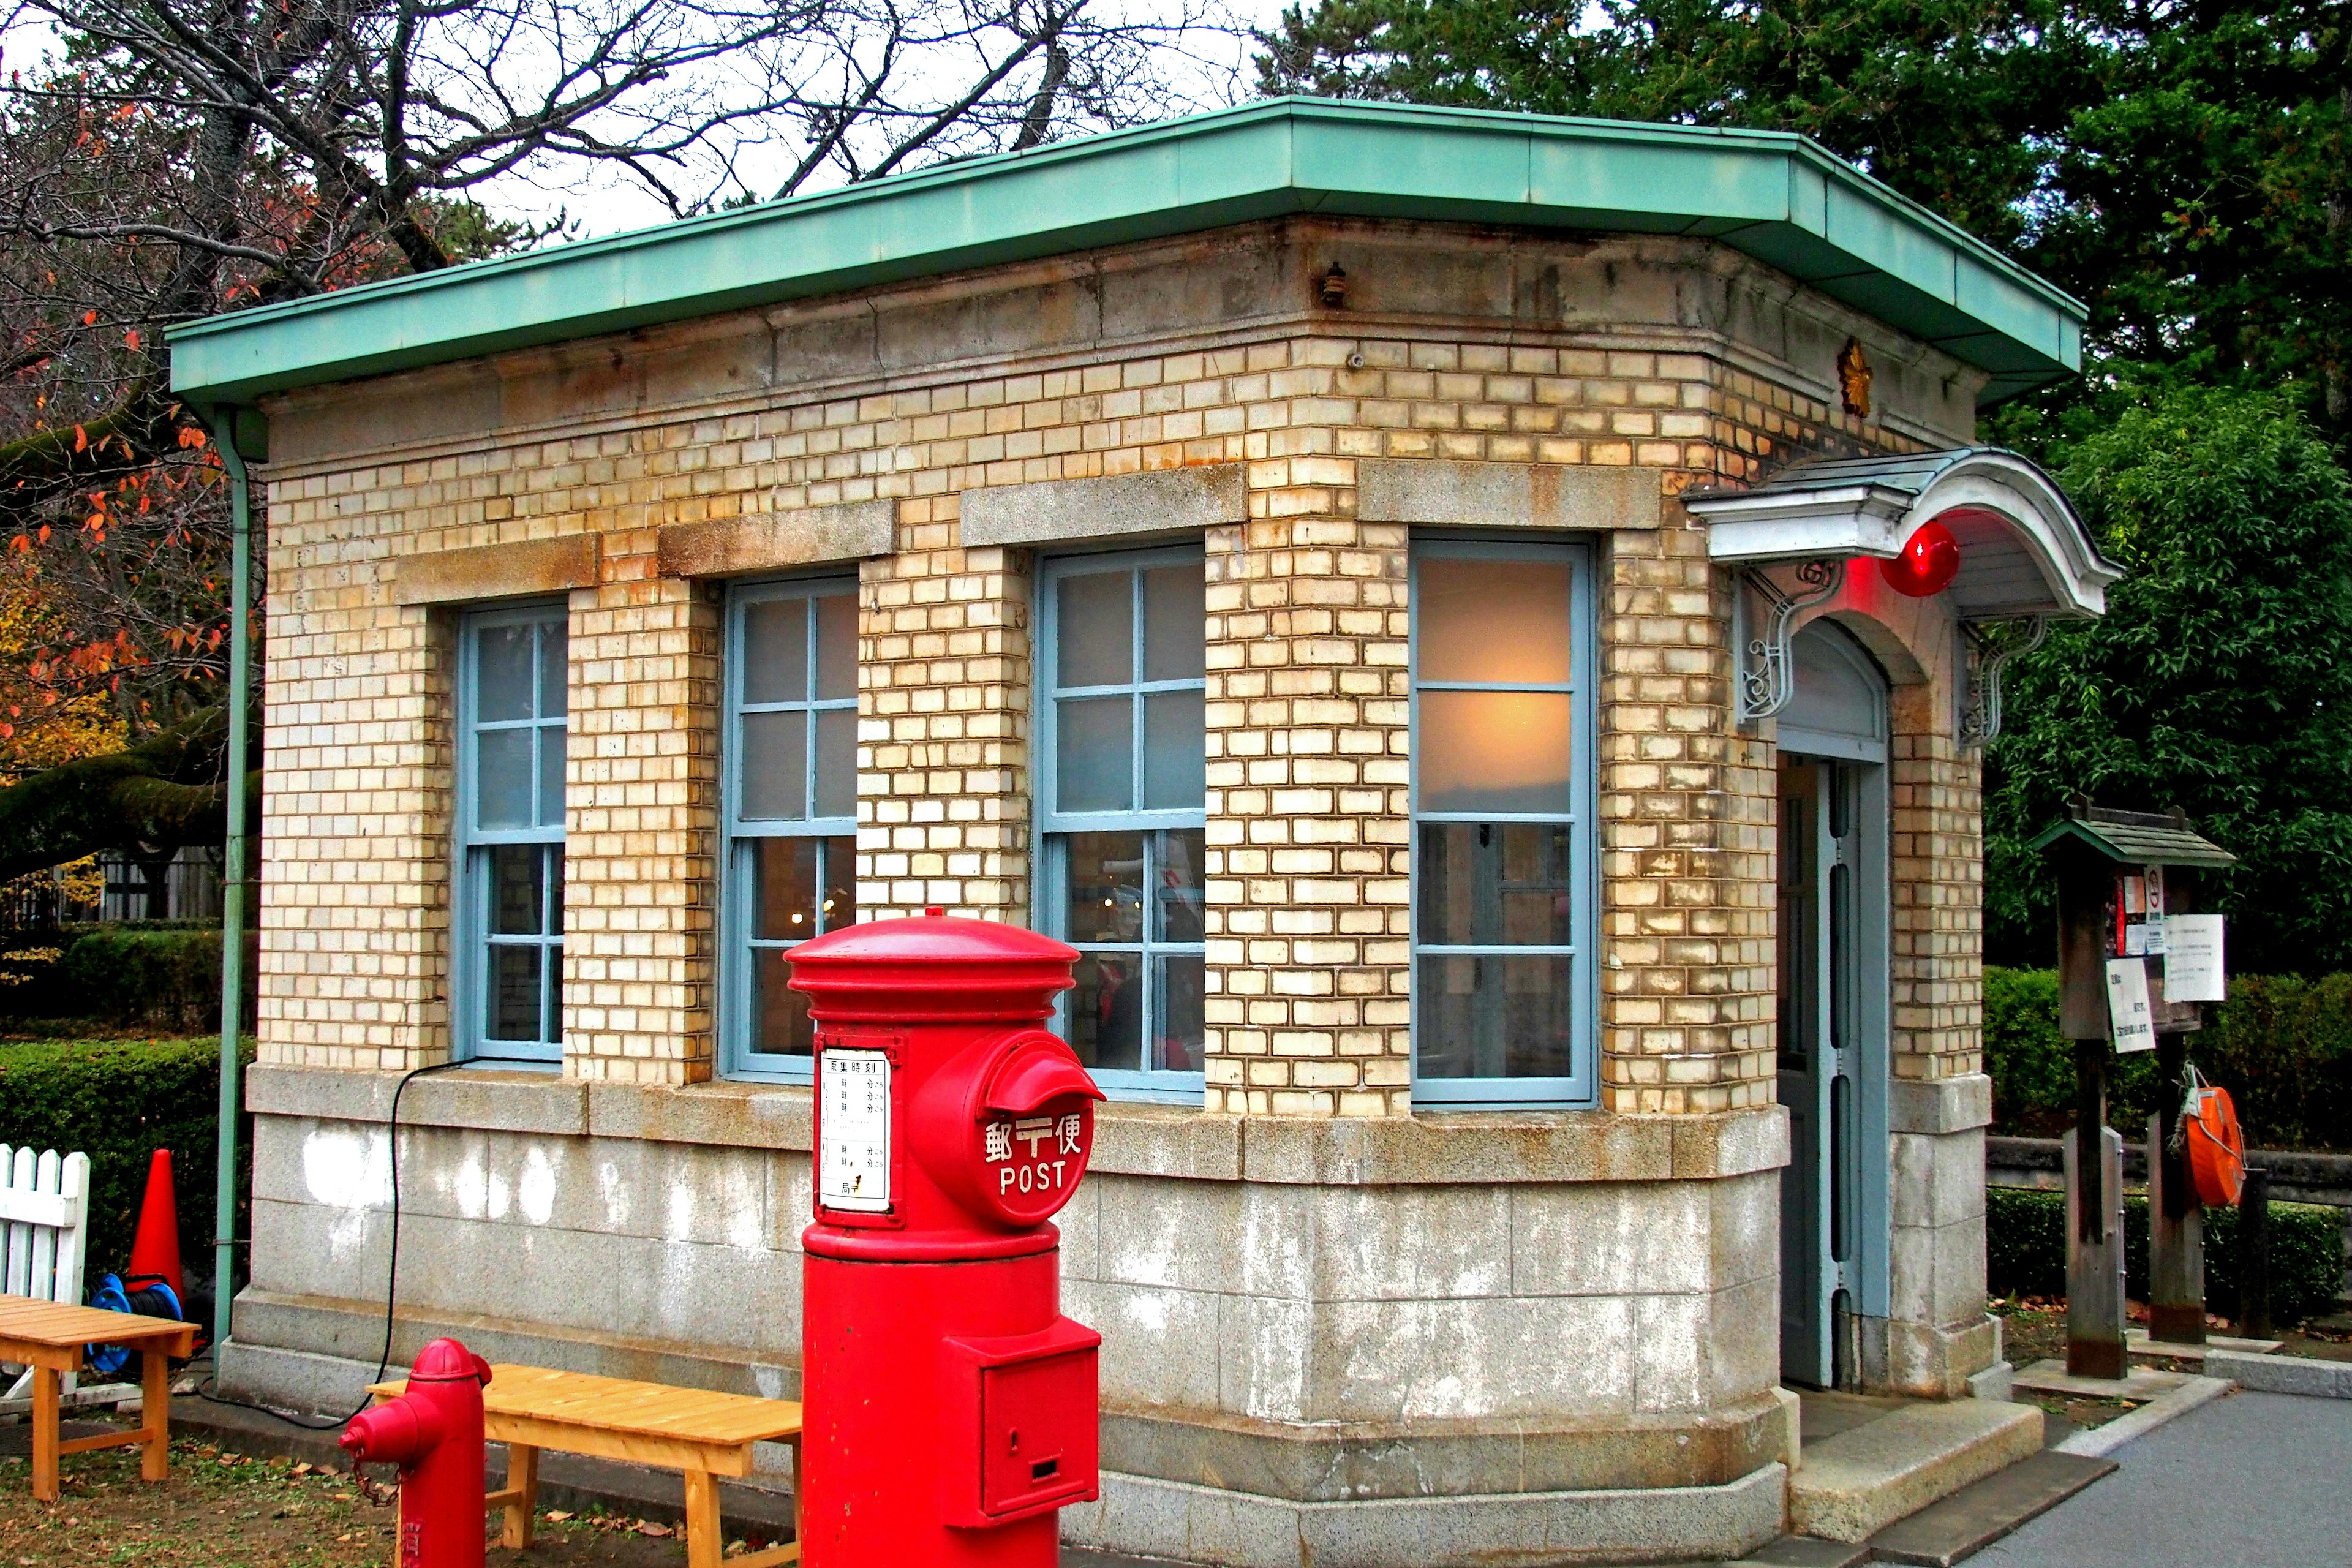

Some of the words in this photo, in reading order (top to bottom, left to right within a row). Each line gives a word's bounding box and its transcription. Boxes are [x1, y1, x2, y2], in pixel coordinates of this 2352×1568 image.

[831, 1060, 876, 1074] 取集時刻
[1000, 1161, 1066, 1195] POST
